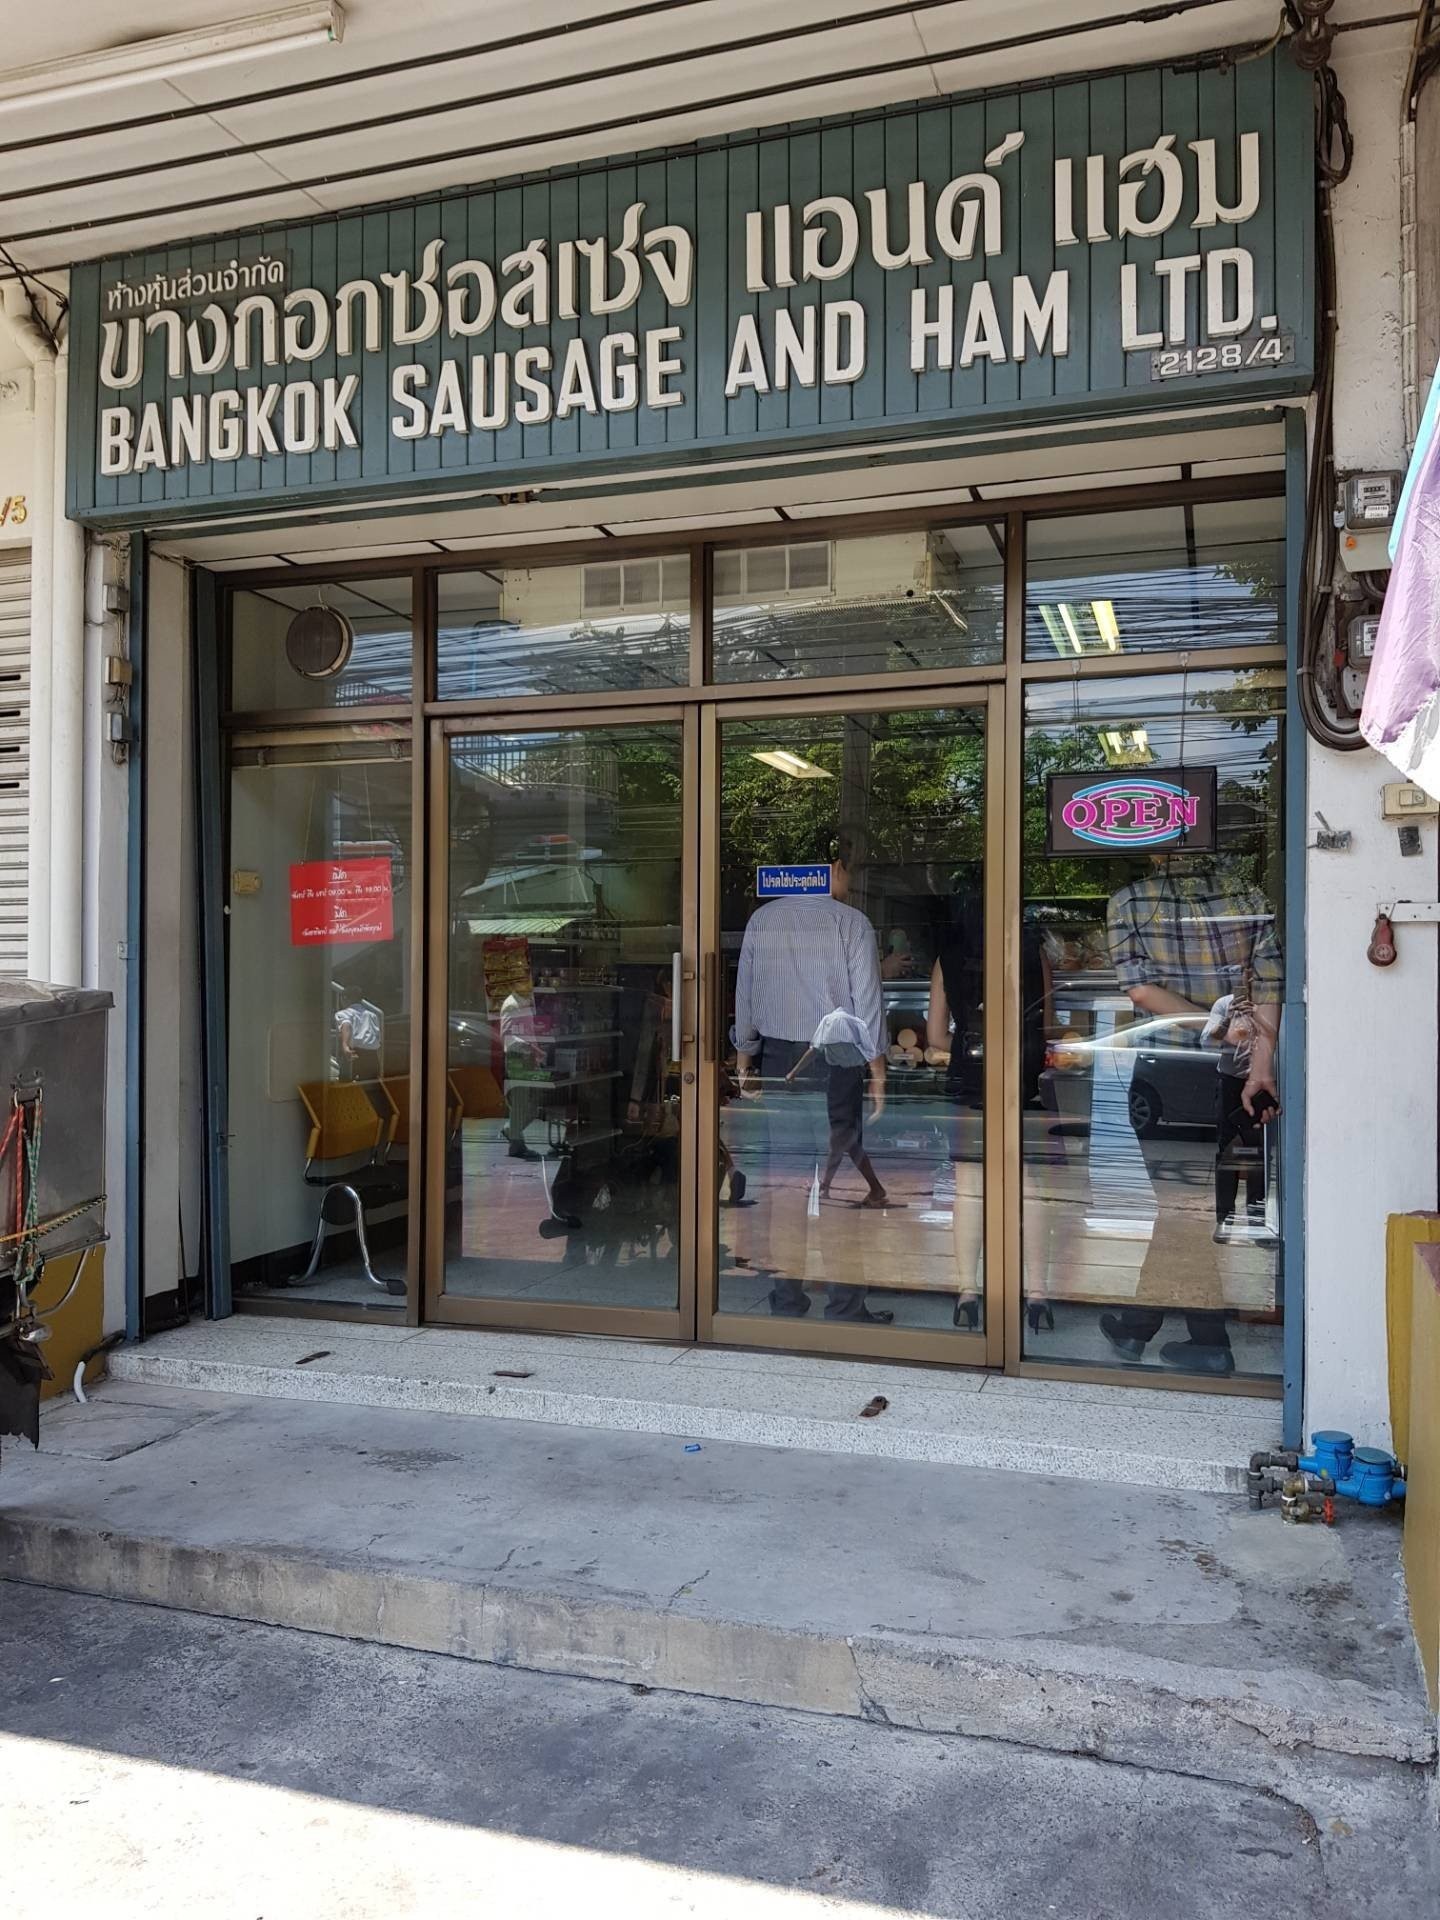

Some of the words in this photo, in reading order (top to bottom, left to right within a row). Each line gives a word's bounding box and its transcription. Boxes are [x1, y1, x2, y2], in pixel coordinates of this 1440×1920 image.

[746, 130, 1025, 293] แอนด์
[1054, 131, 1261, 246] แฮม
[107, 255, 285, 312] ห้างหุ้นส่วนจำกัด
[101, 374, 359, 476] BANGKOK
[391, 326, 686, 439] SAUSAGE
[724, 299, 866, 398] AND
[910, 269, 1069, 373] HAM
[1120, 247, 1279, 353] LTD.
[1159, 336, 1284, 376] 2128/4
[0, 495, 27, 527] /5
[1062, 796, 1200, 829] OPEN
